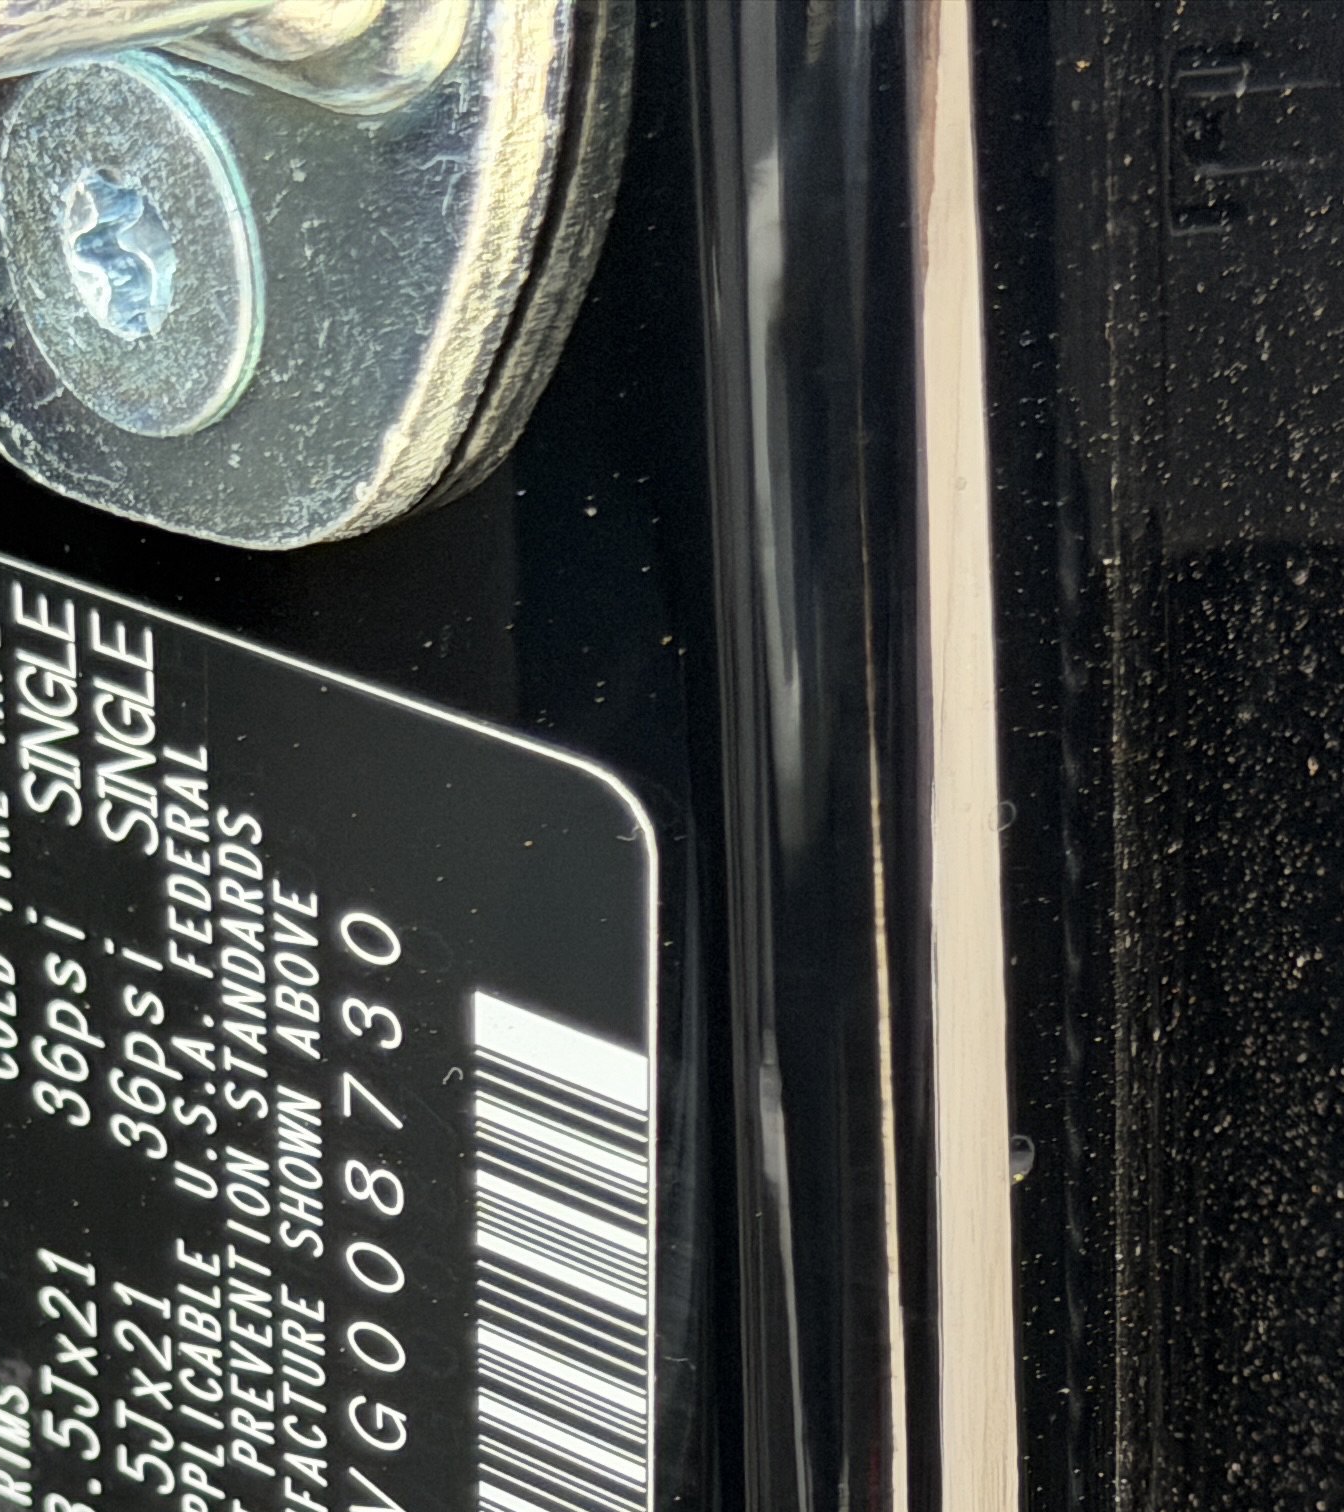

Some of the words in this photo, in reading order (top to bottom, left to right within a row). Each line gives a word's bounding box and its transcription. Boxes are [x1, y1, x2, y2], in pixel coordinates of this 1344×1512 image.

[11, 579, 82, 825] SINGLE
[90, 607, 160, 856] SINGLE
[163, 743, 214, 979] FEDERAL
[217, 803, 270, 1119] STANDARDS
[272, 877, 321, 1059] ABOVE
[25, 905, 106, 1126] 36psi
[103, 937, 183, 1159] 36psi
[171, 1014, 219, 1198] U.S.A.
[276, 1084, 325, 1257] SHOWN
[225, 1145, 276, 1476] PREVENTION
